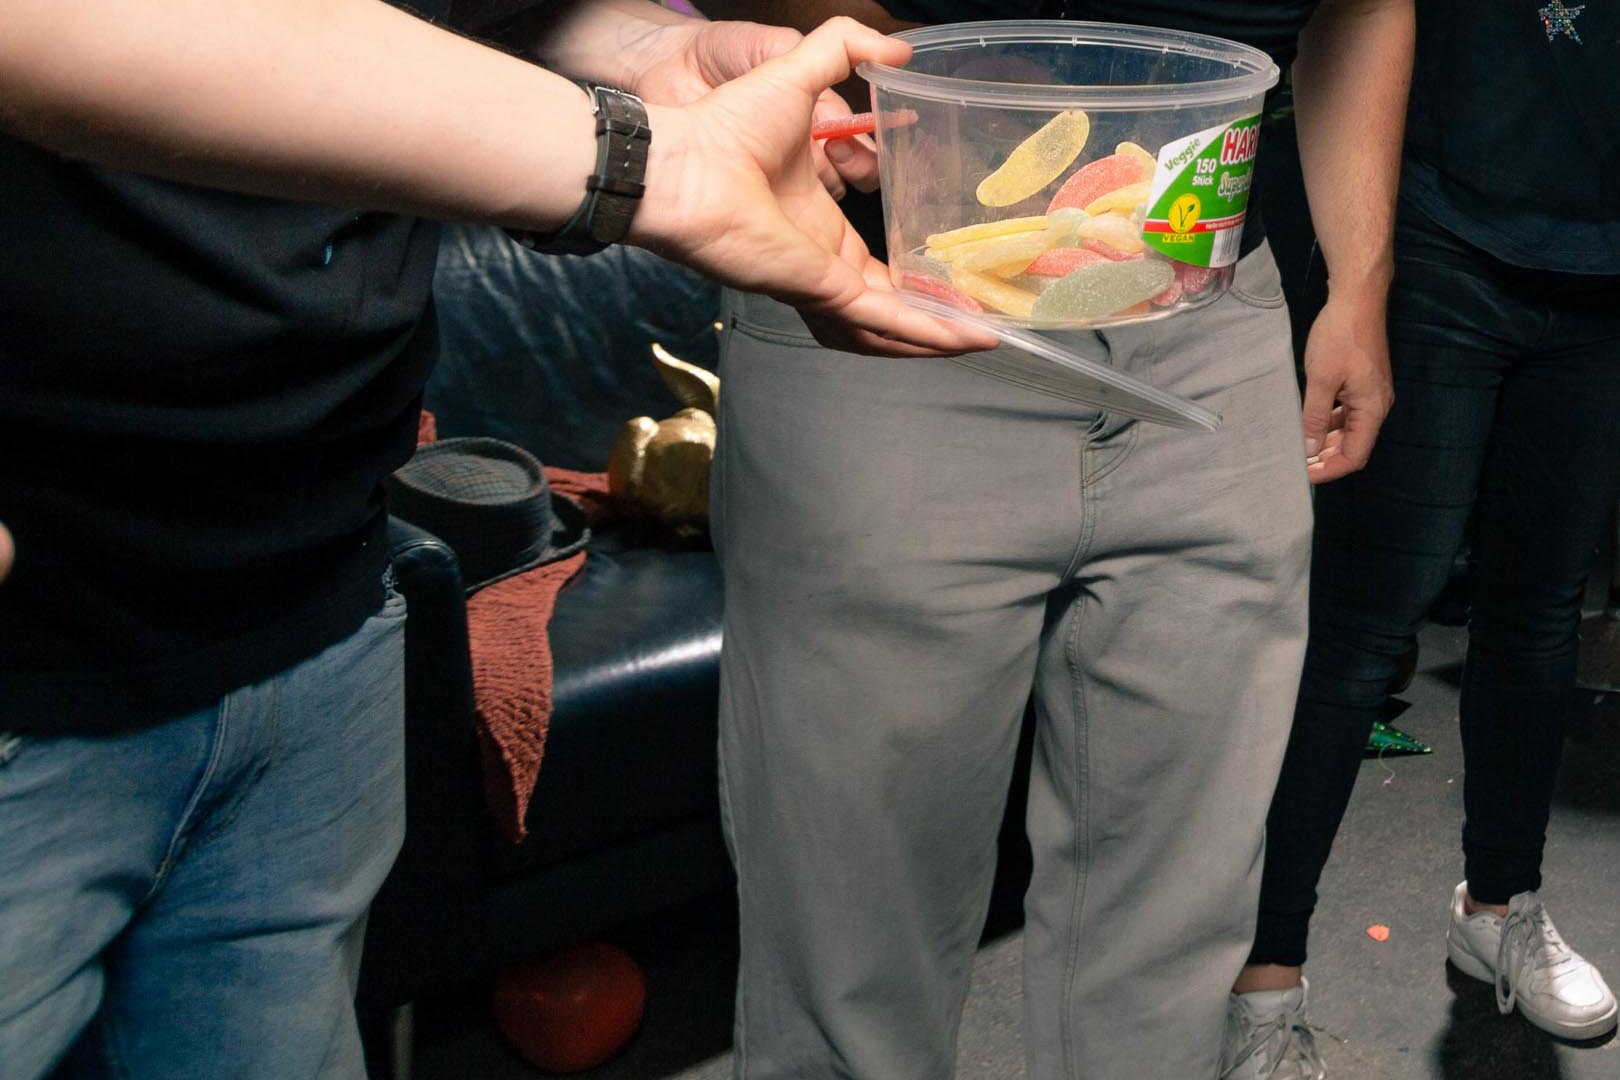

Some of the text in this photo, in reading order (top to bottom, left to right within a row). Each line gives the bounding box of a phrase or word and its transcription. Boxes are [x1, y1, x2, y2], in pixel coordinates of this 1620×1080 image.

[1220, 126, 1258, 164] HAR
[1164, 138, 1201, 171] Veggie
[1196, 158, 1217, 173] 150
[1192, 175, 1214, 187] Stück
[1163, 234, 1195, 242] VEGAN
